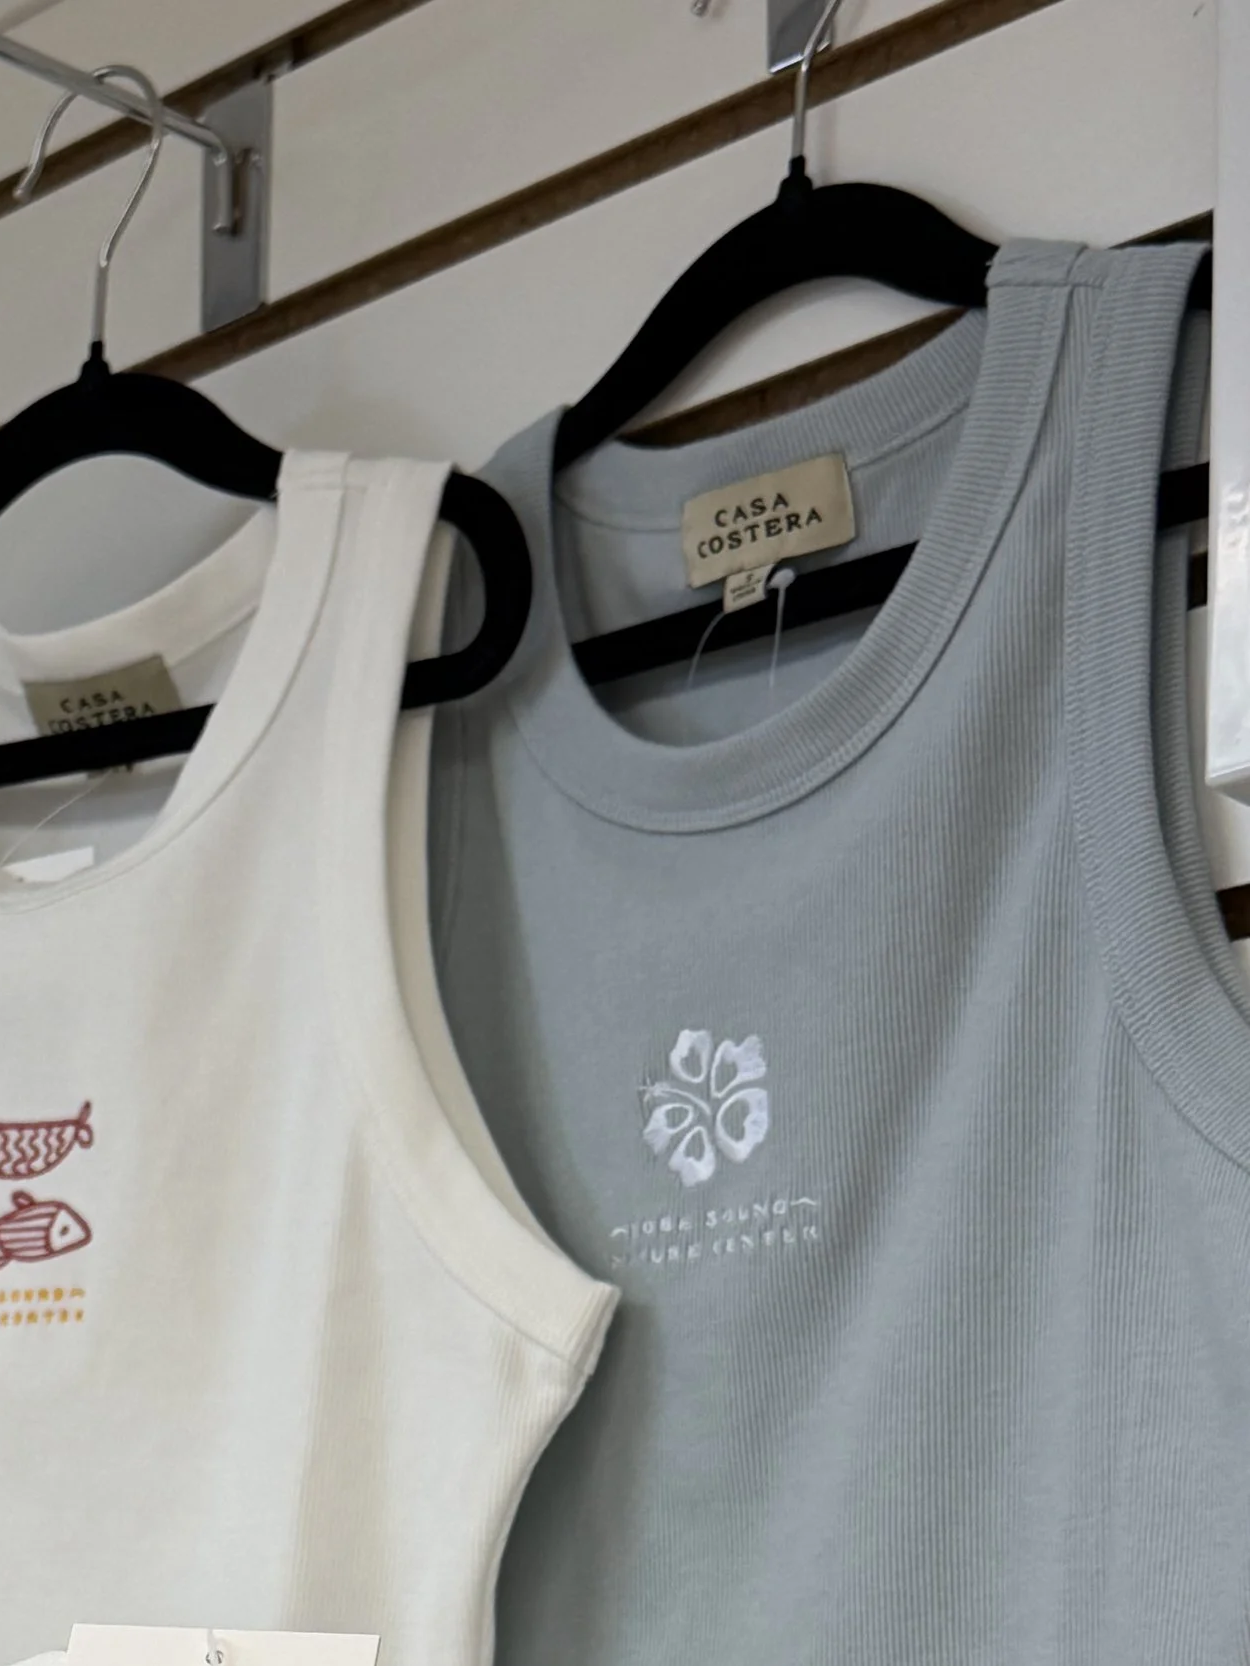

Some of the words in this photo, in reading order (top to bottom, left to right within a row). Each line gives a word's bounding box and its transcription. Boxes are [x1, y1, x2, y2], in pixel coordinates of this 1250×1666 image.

[714, 493, 789, 527] CASA
[697, 508, 823, 558] COSTERA
[60, 690, 124, 714] CASA
